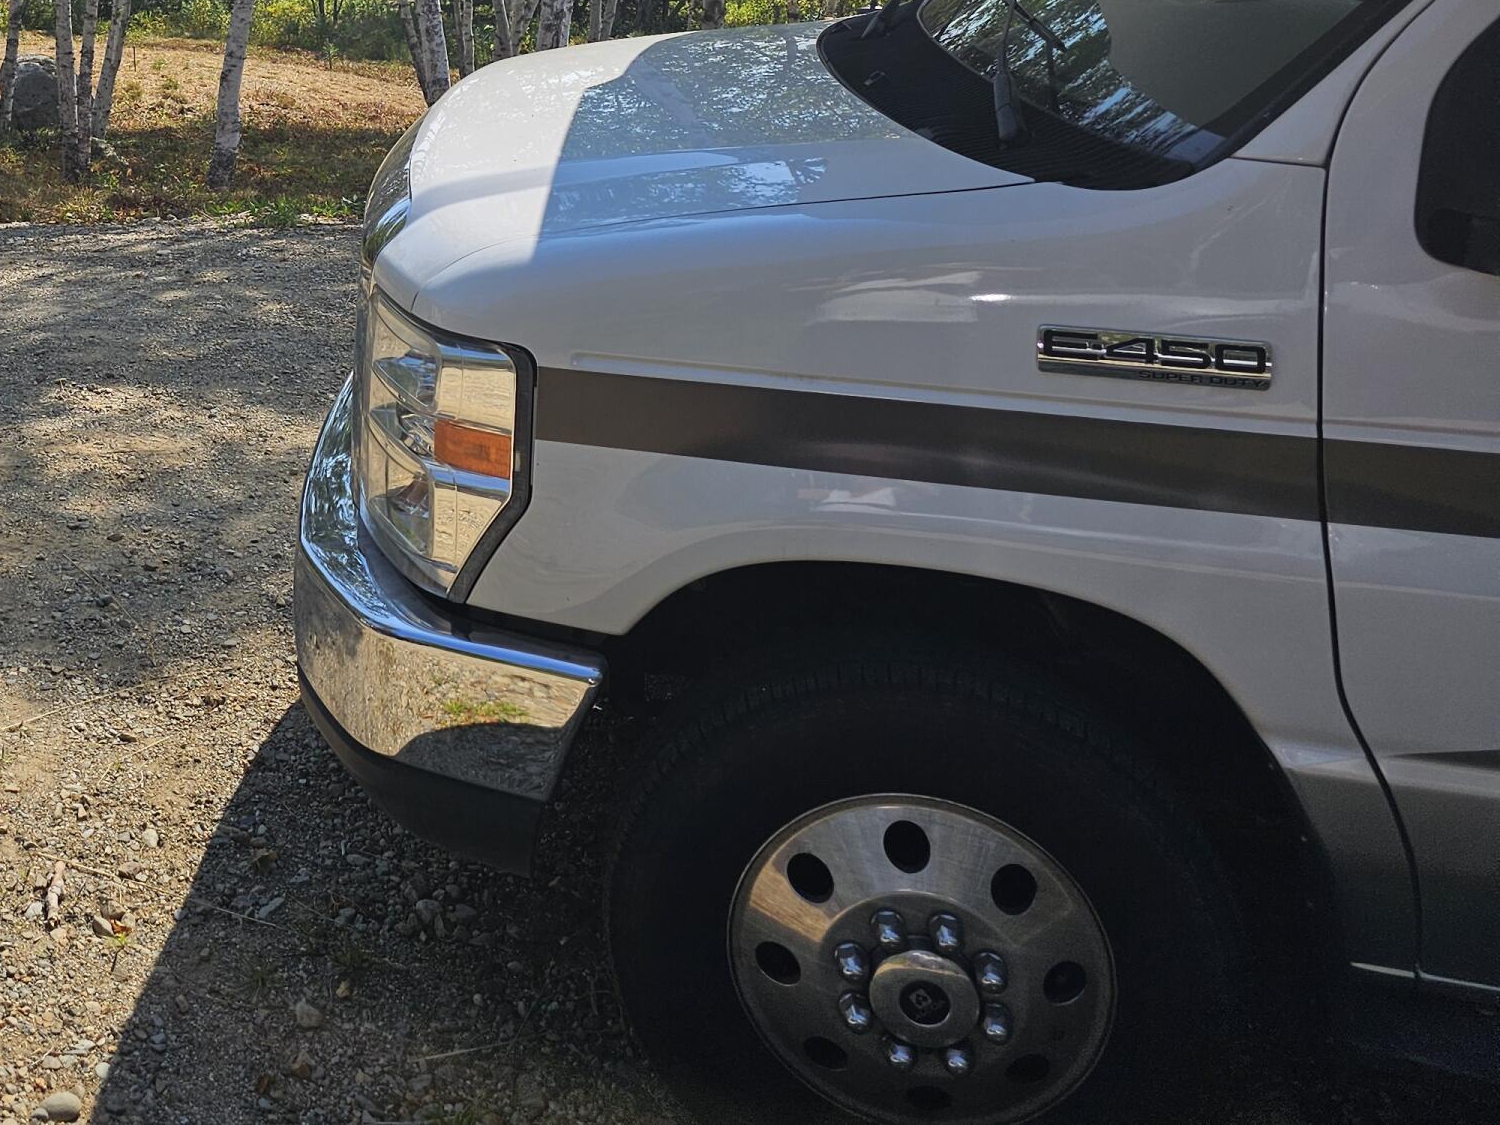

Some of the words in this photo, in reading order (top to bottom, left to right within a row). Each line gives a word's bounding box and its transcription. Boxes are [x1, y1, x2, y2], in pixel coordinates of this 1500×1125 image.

[1043, 329, 1267, 373] E-450
[1138, 370, 1202, 383] SUPER
[1210, 377, 1264, 388] DUTY
